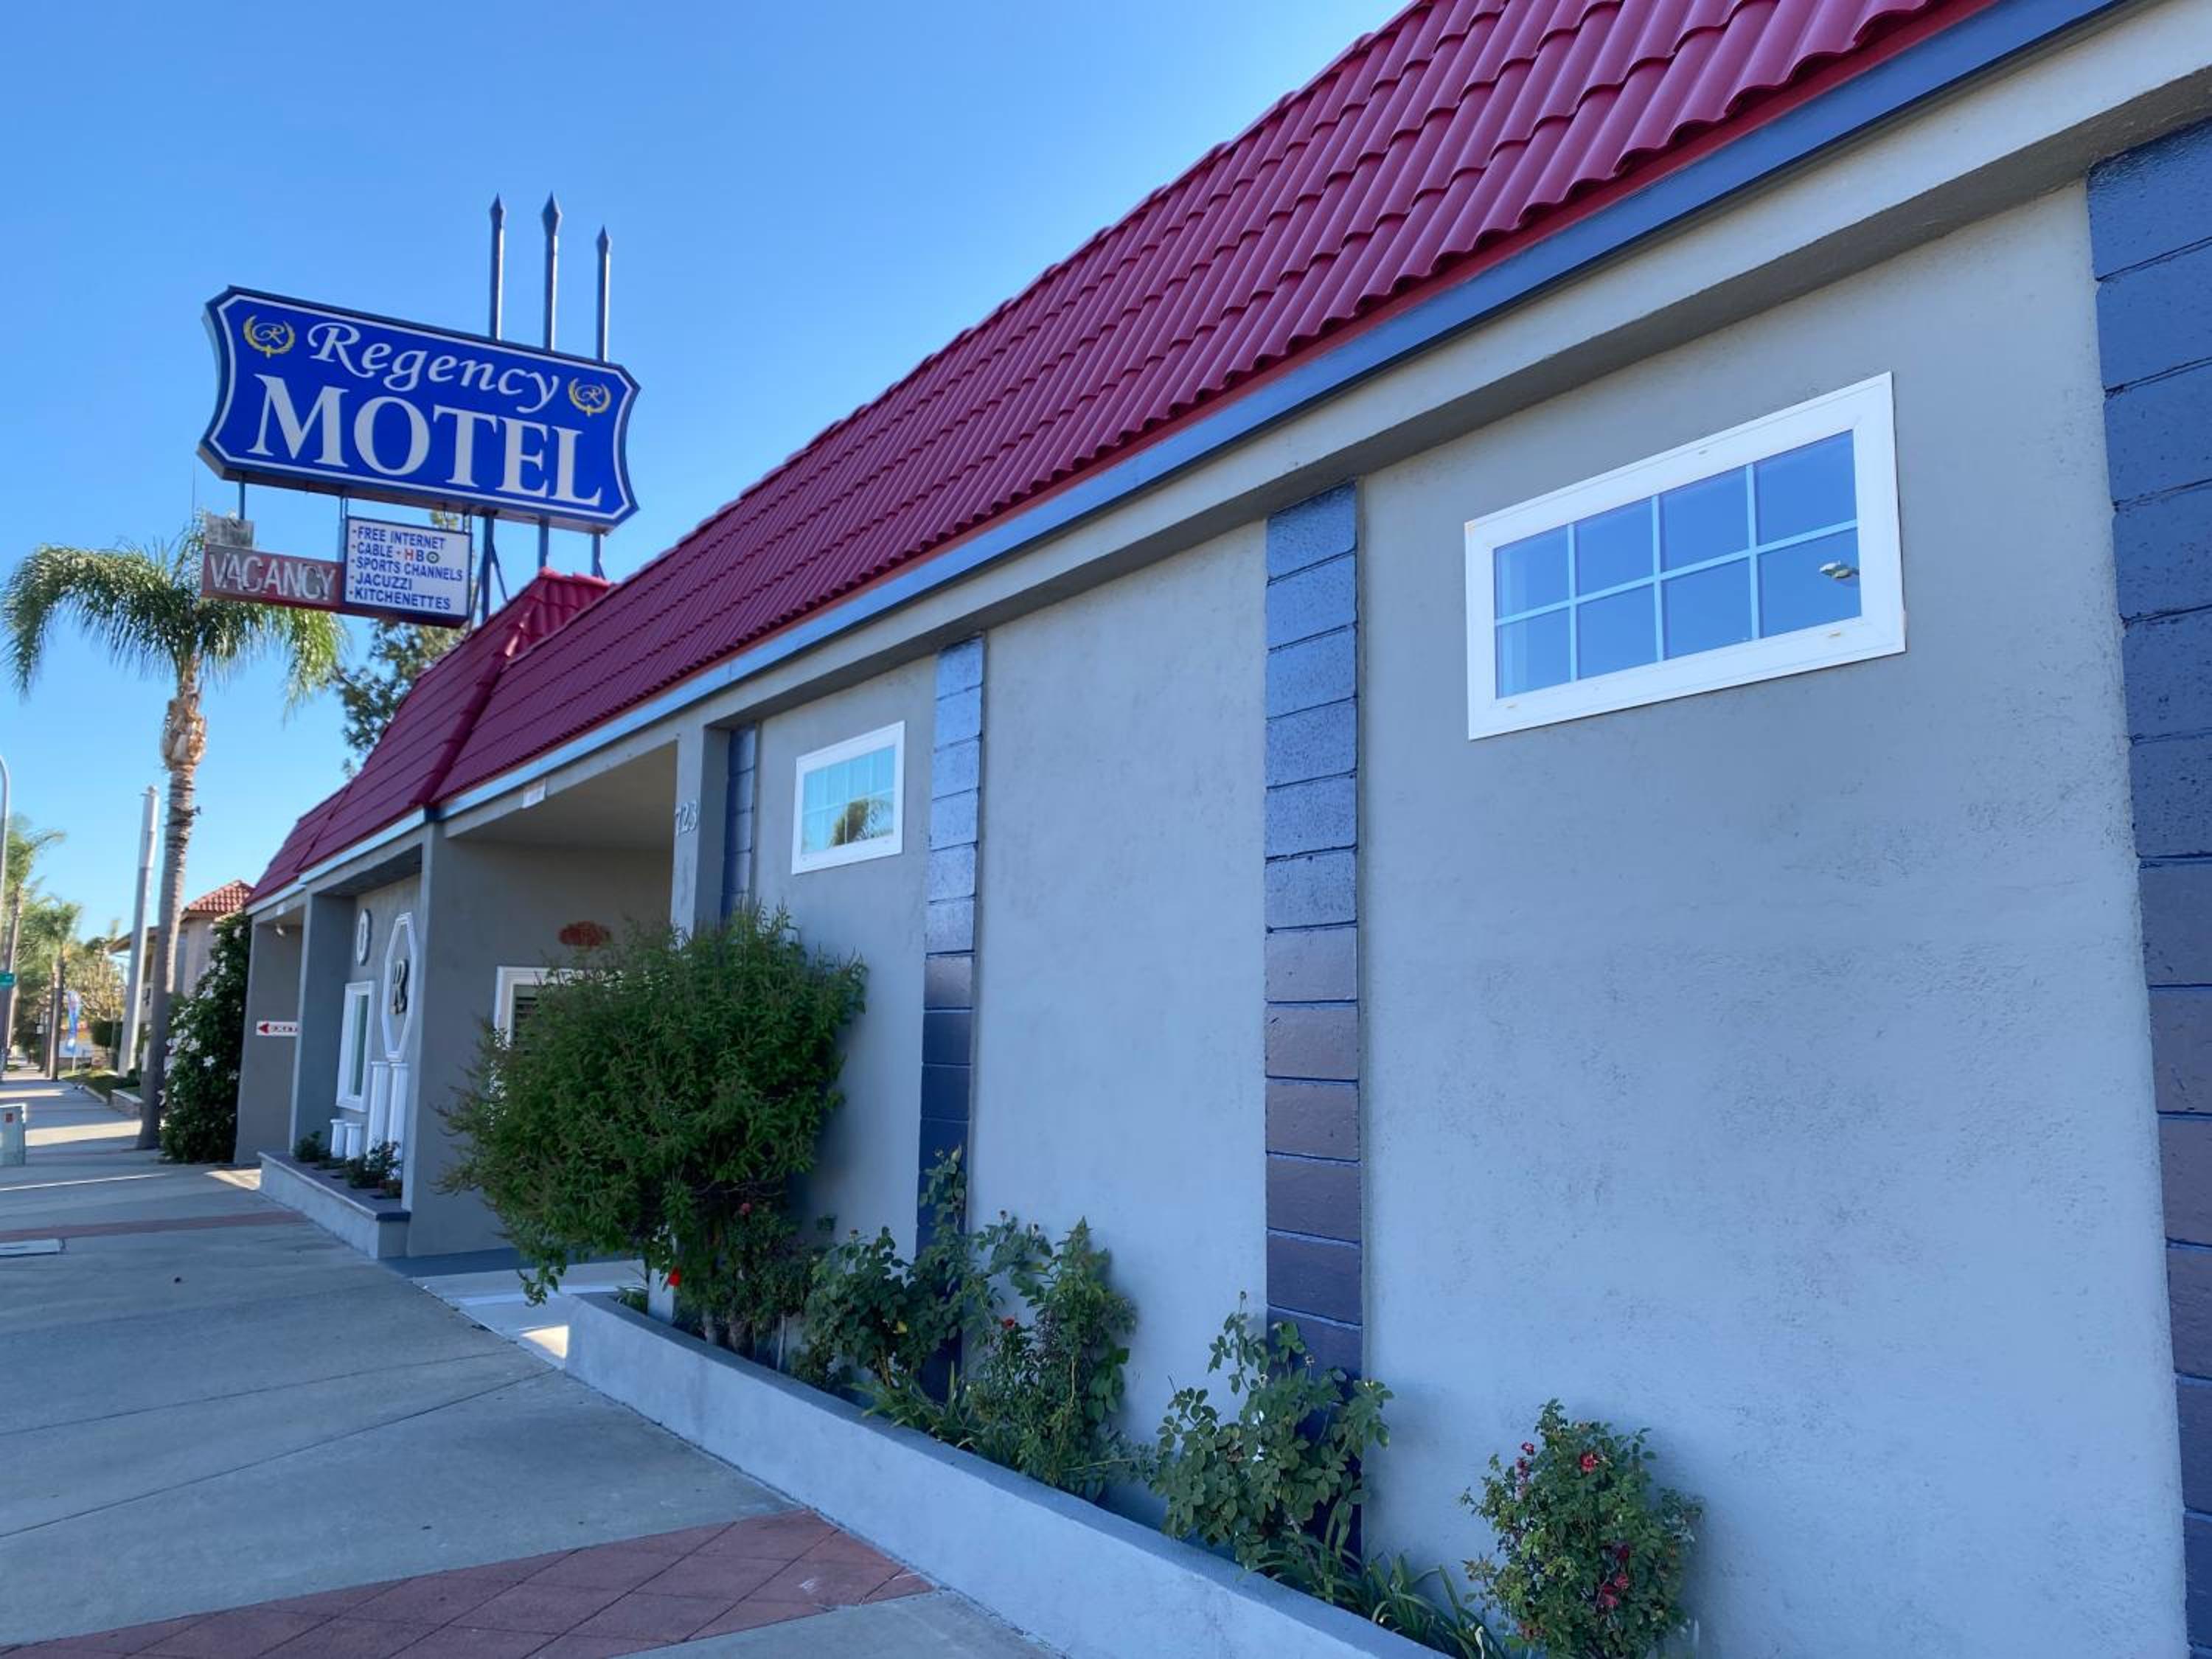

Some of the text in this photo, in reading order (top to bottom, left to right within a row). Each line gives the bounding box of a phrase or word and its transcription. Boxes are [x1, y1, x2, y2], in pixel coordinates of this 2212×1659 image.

[307, 322, 559, 414] Regency
[247, 374, 601, 507] MOTEL
[358, 526, 445, 549] FREE INTERNET
[357, 542, 393, 558] CABLE
[209, 552, 335, 601] VACANCY
[356, 556, 462, 581] SPORTS CHANNELS
[356, 572, 412, 591] JACUZZI
[355, 587, 451, 610] KITCHENETTES
